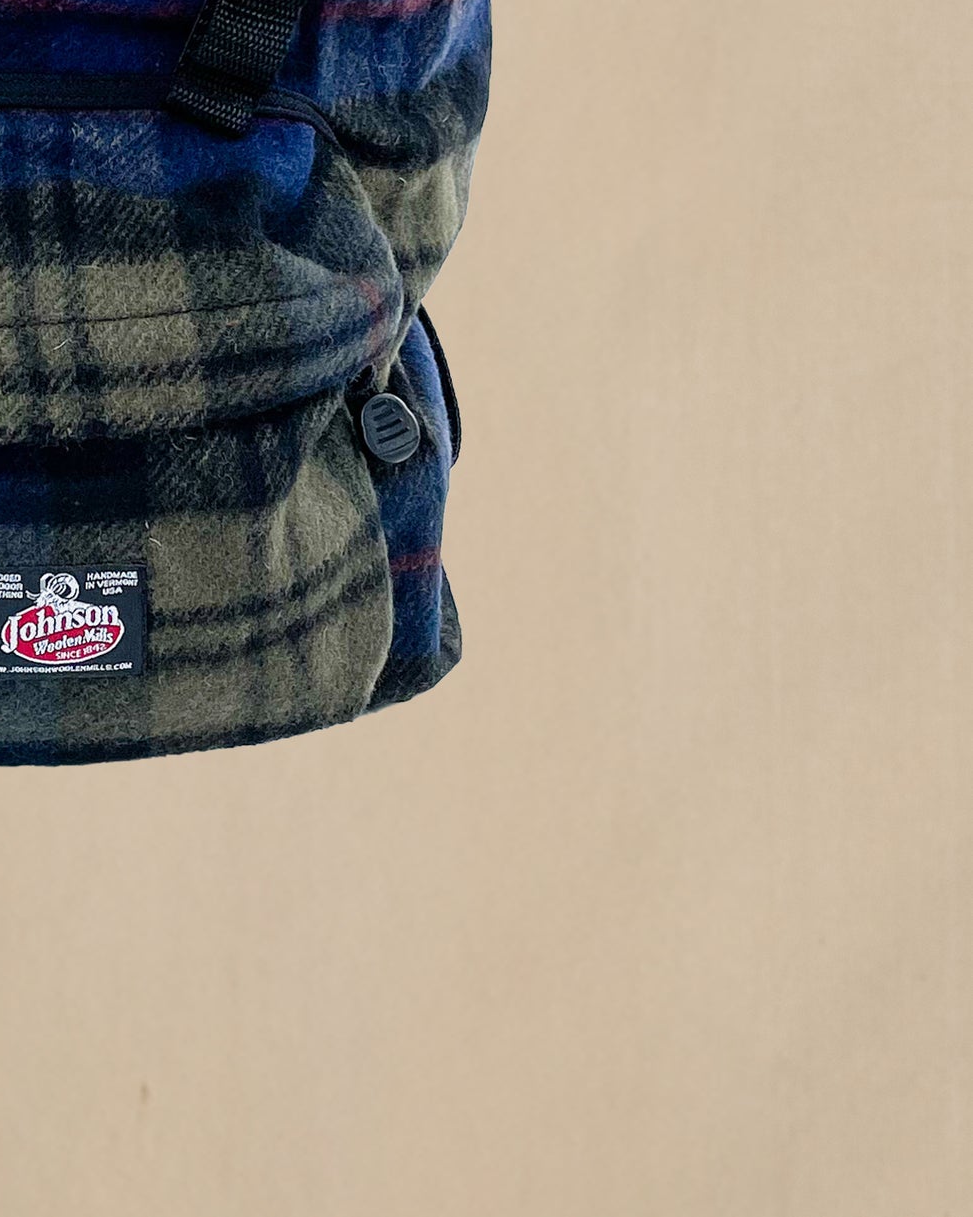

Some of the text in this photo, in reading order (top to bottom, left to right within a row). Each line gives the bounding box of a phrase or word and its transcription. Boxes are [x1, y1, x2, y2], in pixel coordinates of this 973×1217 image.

[87, 571, 138, 581] HANDMADE
[85, 579, 138, 590] IN VERMONT
[102, 587, 123, 595] USA
[1, 605, 120, 653] Johnson
[33, 627, 114, 656] Woolen Mills
[55, 644, 107, 660] SINCE 1842
